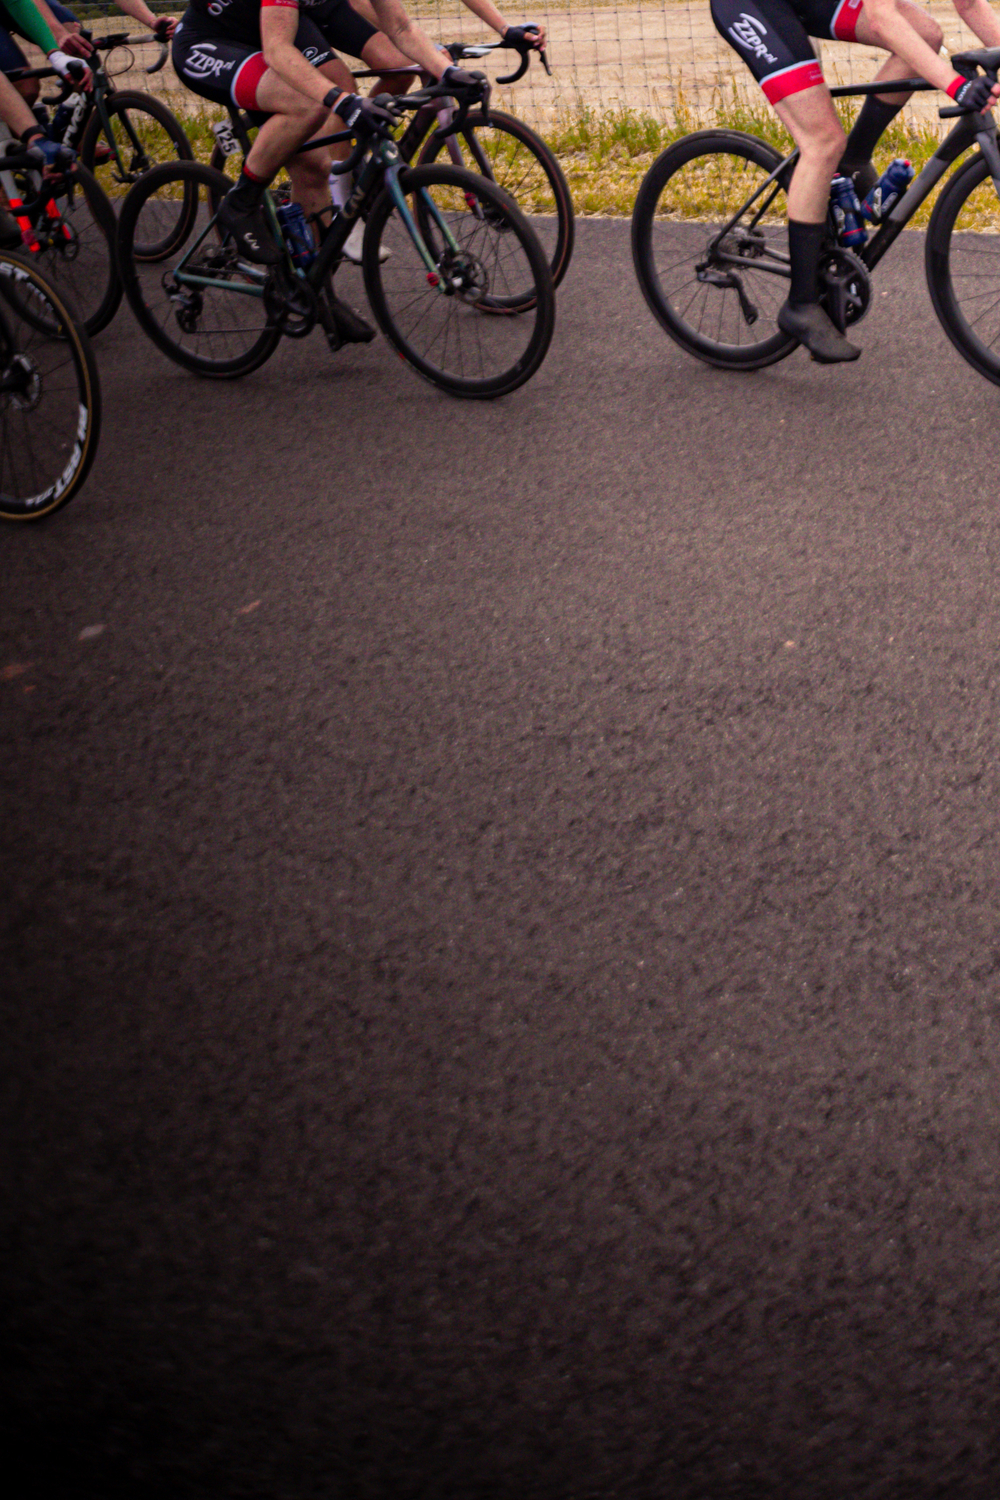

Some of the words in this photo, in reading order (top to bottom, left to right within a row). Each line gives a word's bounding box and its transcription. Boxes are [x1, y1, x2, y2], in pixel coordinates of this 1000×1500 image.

[732, 19, 779, 65] ZZPR.nl
[184, 50, 236, 78] ZZPR.nl
[216, 125, 239, 154] 125
